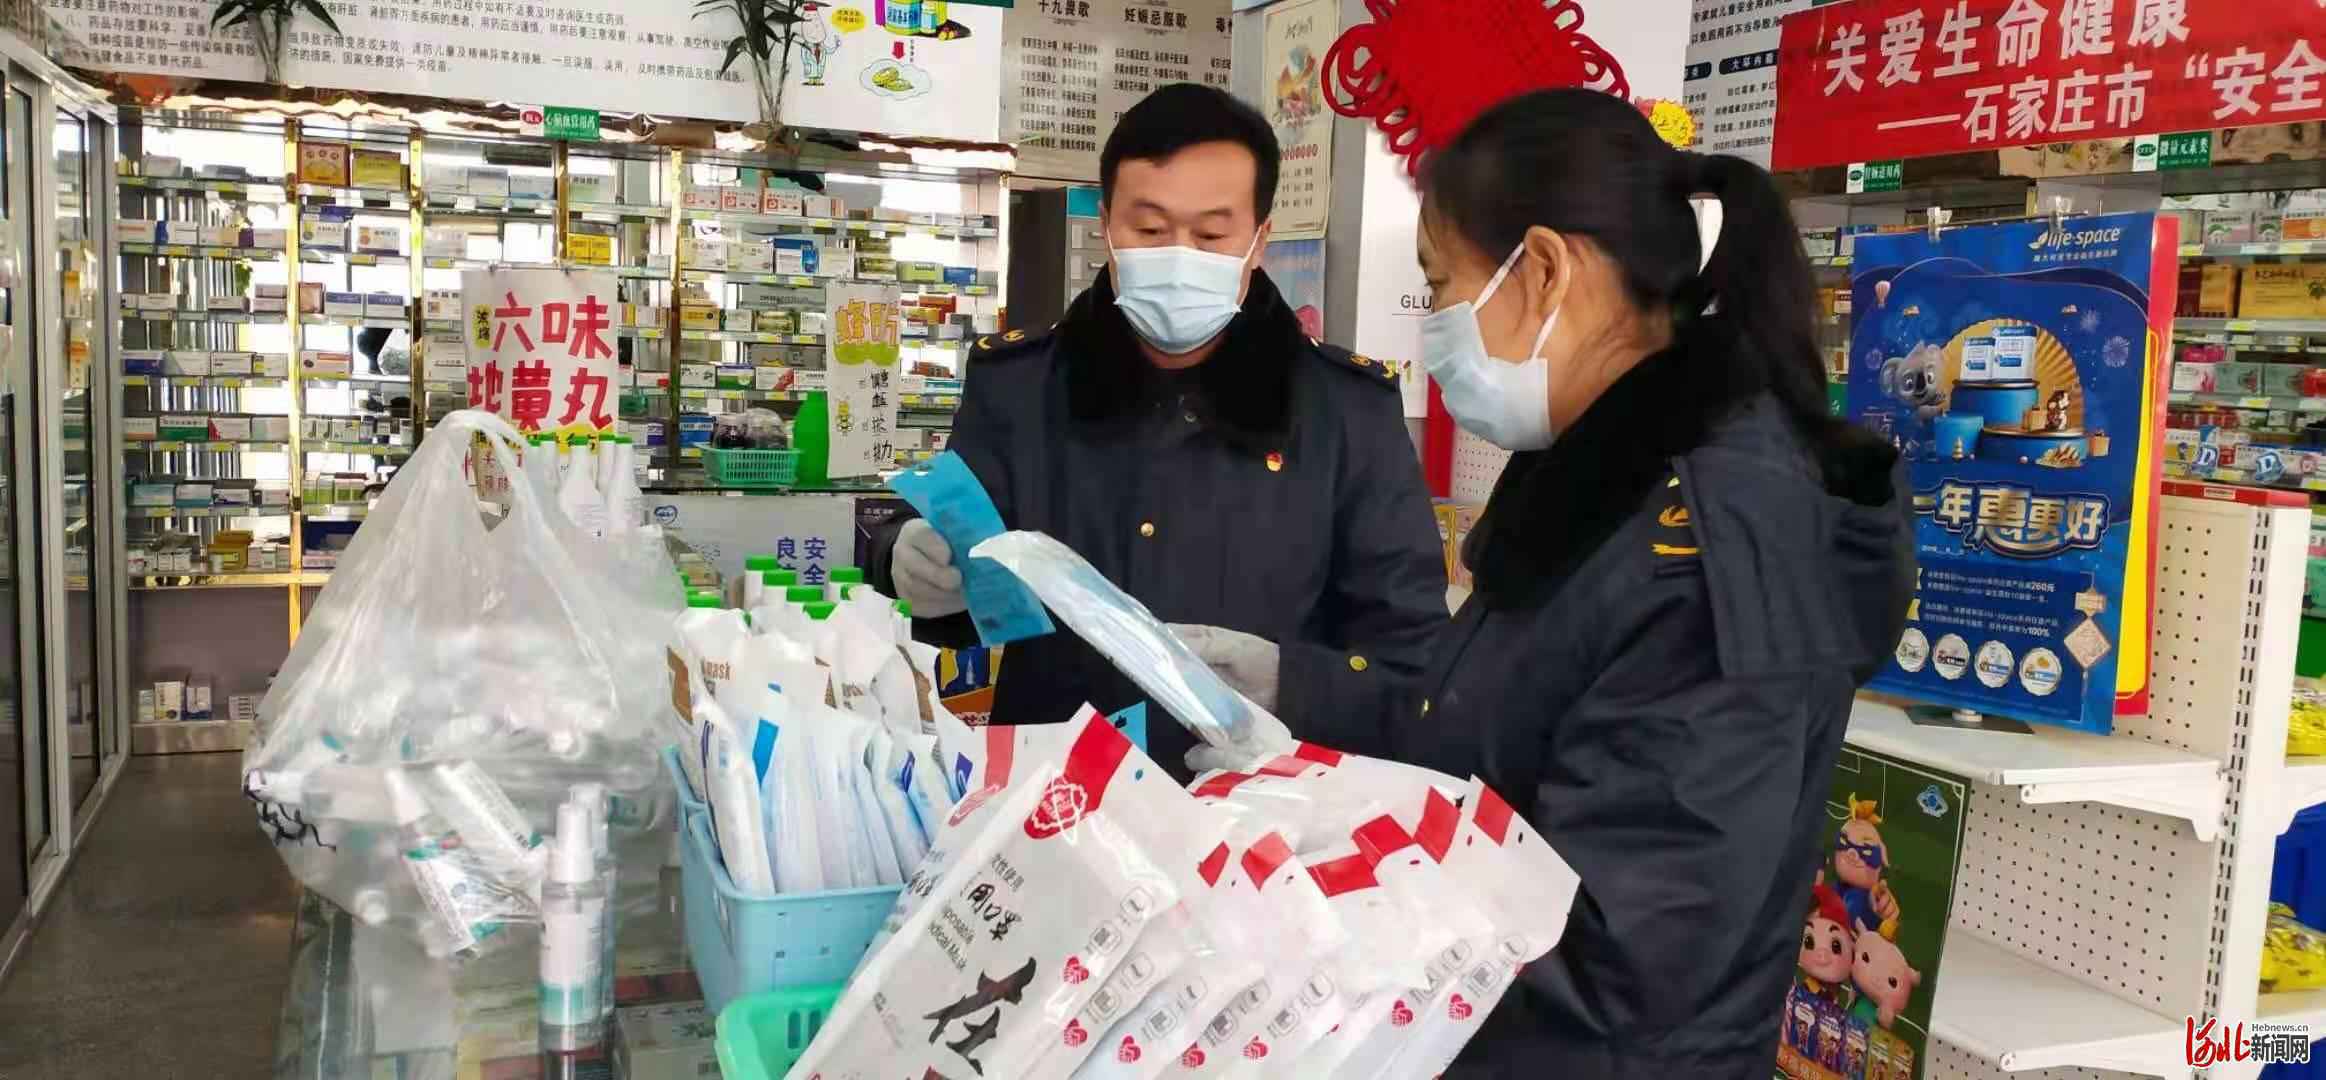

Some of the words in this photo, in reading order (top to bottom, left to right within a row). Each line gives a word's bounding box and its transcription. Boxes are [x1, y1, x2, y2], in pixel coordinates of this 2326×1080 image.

[1124, 7, 1188, 29] 妊娠忌服歌
[1824, 0, 2190, 96] 关爱生命健康
[493, 290, 613, 359] 六味
[1400, 294, 1433, 309] GLU
[467, 360, 613, 431] 地黄丸
